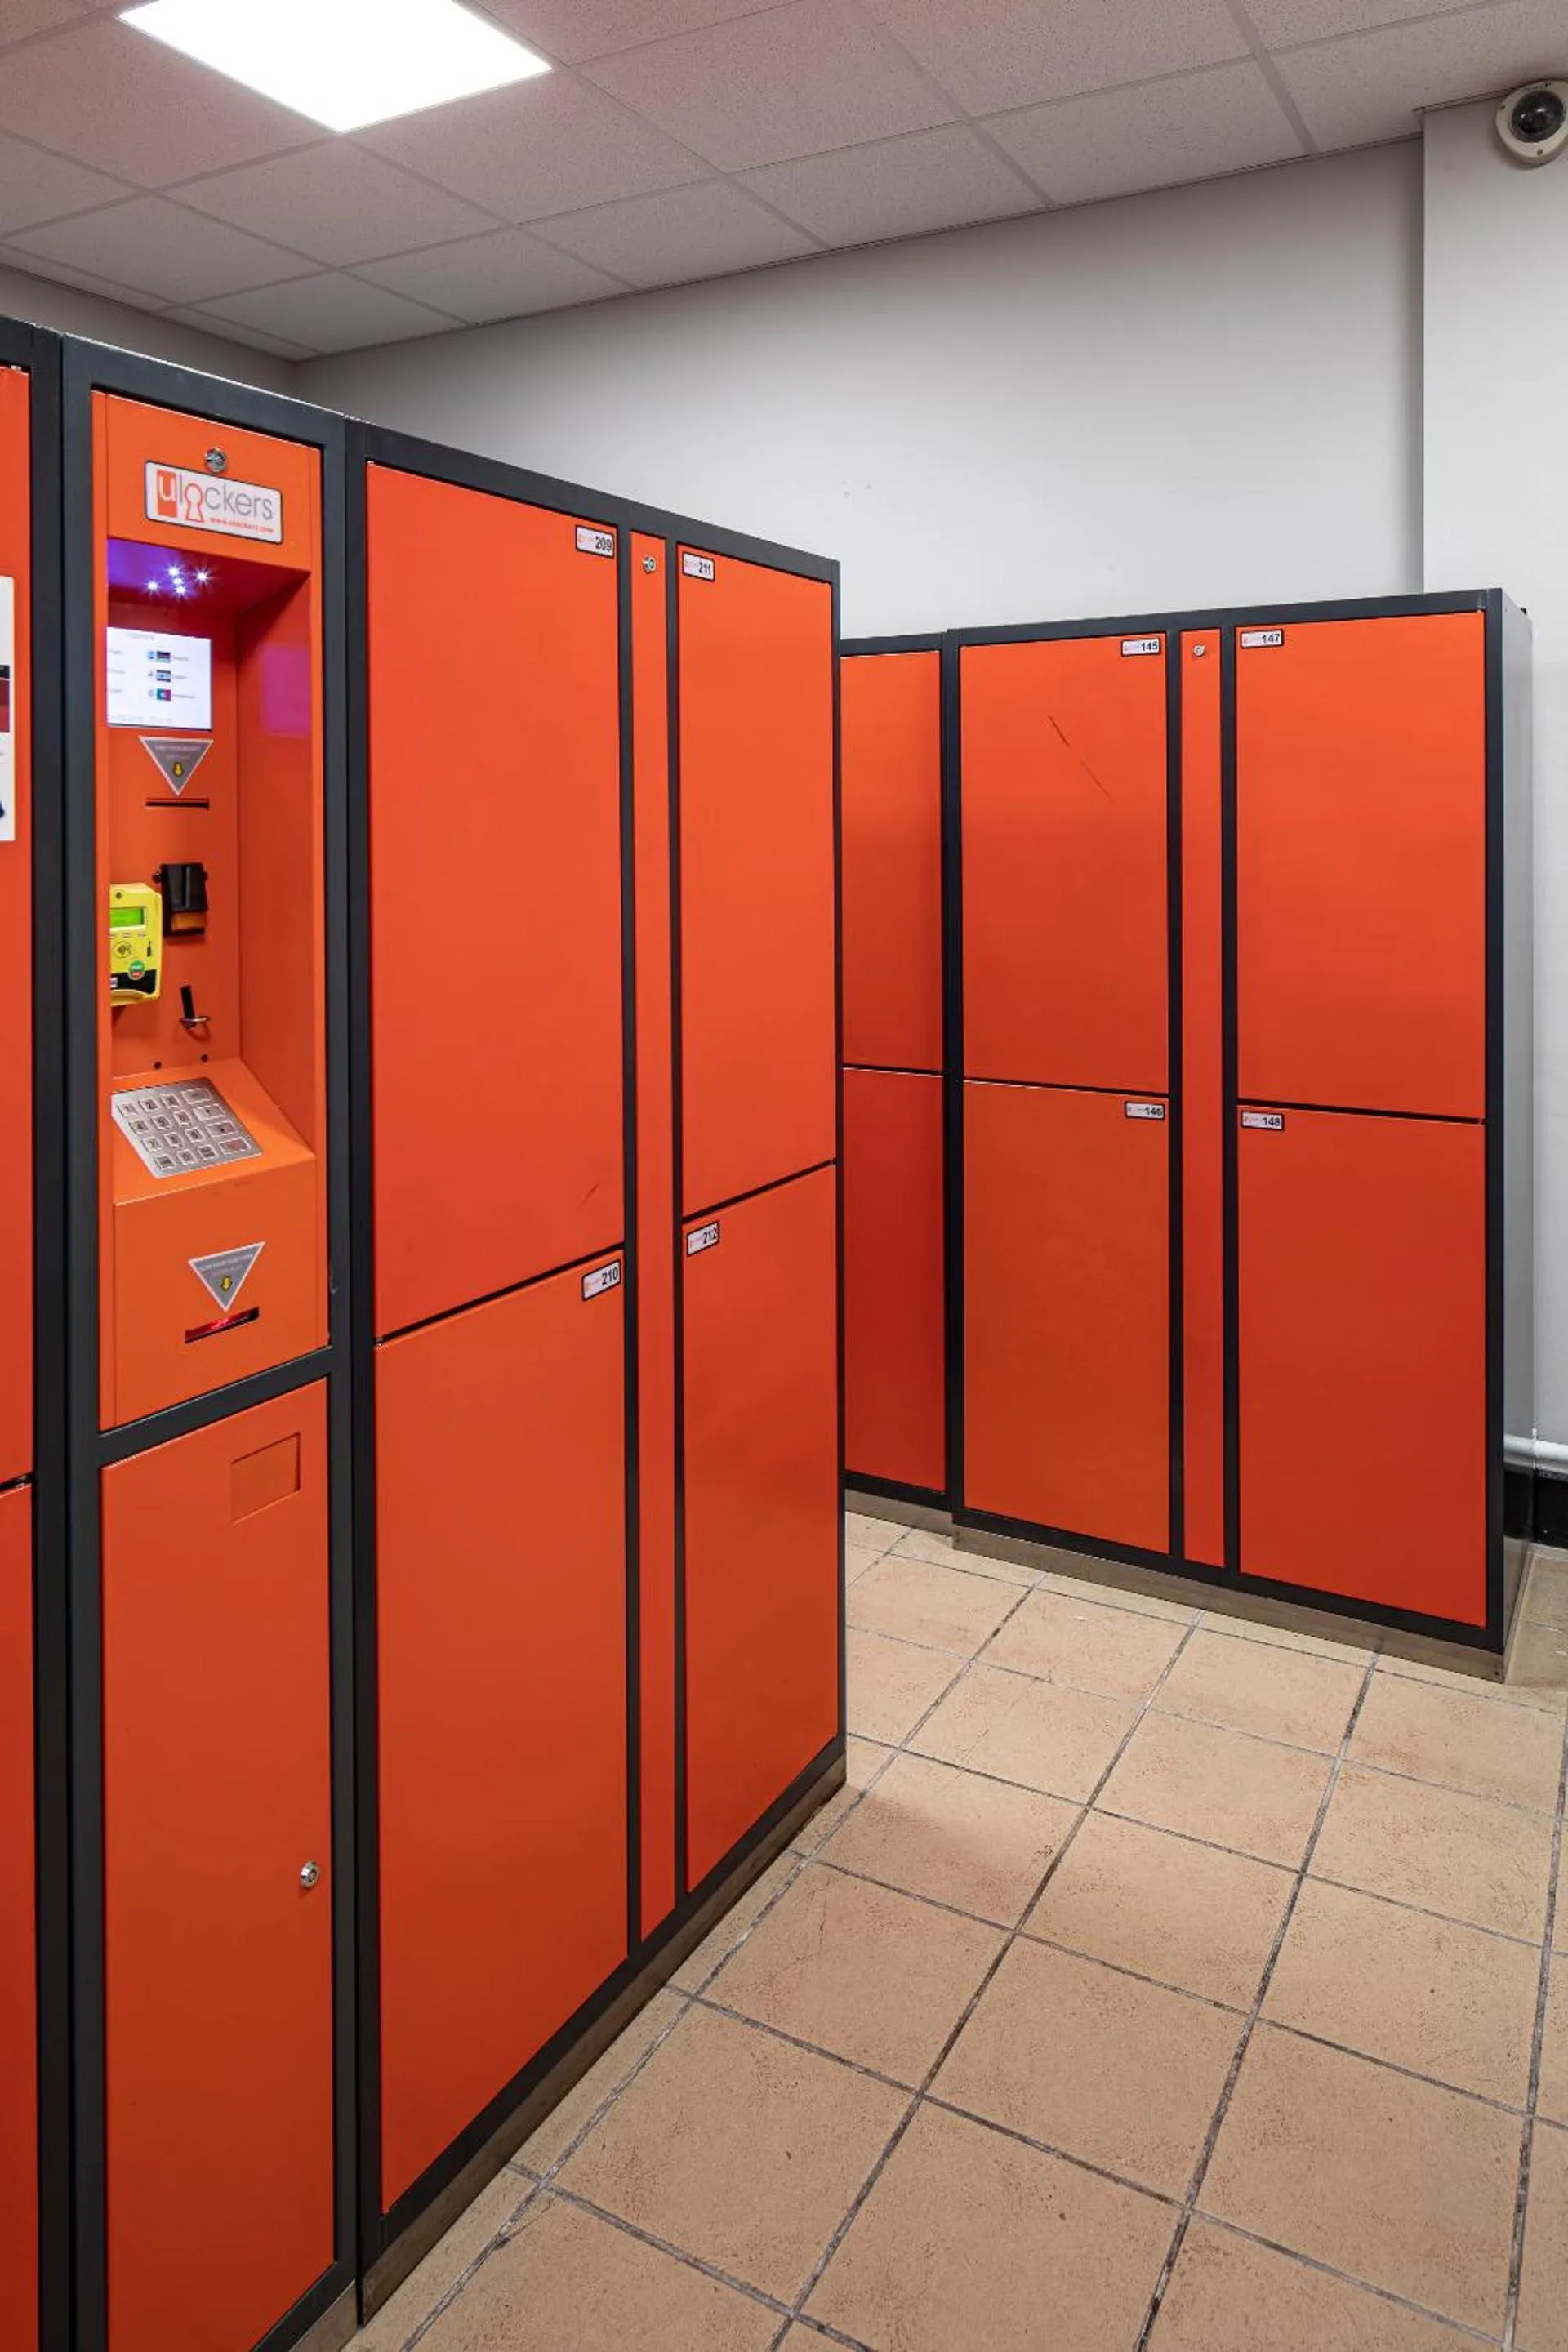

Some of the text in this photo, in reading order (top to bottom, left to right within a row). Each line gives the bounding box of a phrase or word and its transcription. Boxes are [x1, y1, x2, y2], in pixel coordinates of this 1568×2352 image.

[158, 471, 274, 523] ulockers
[699, 562, 711, 576] 211
[1262, 633, 1281, 643] 147
[1141, 641, 1158, 652] 145
[1263, 1116, 1281, 1126] 148
[602, 1267, 618, 1285] 210
